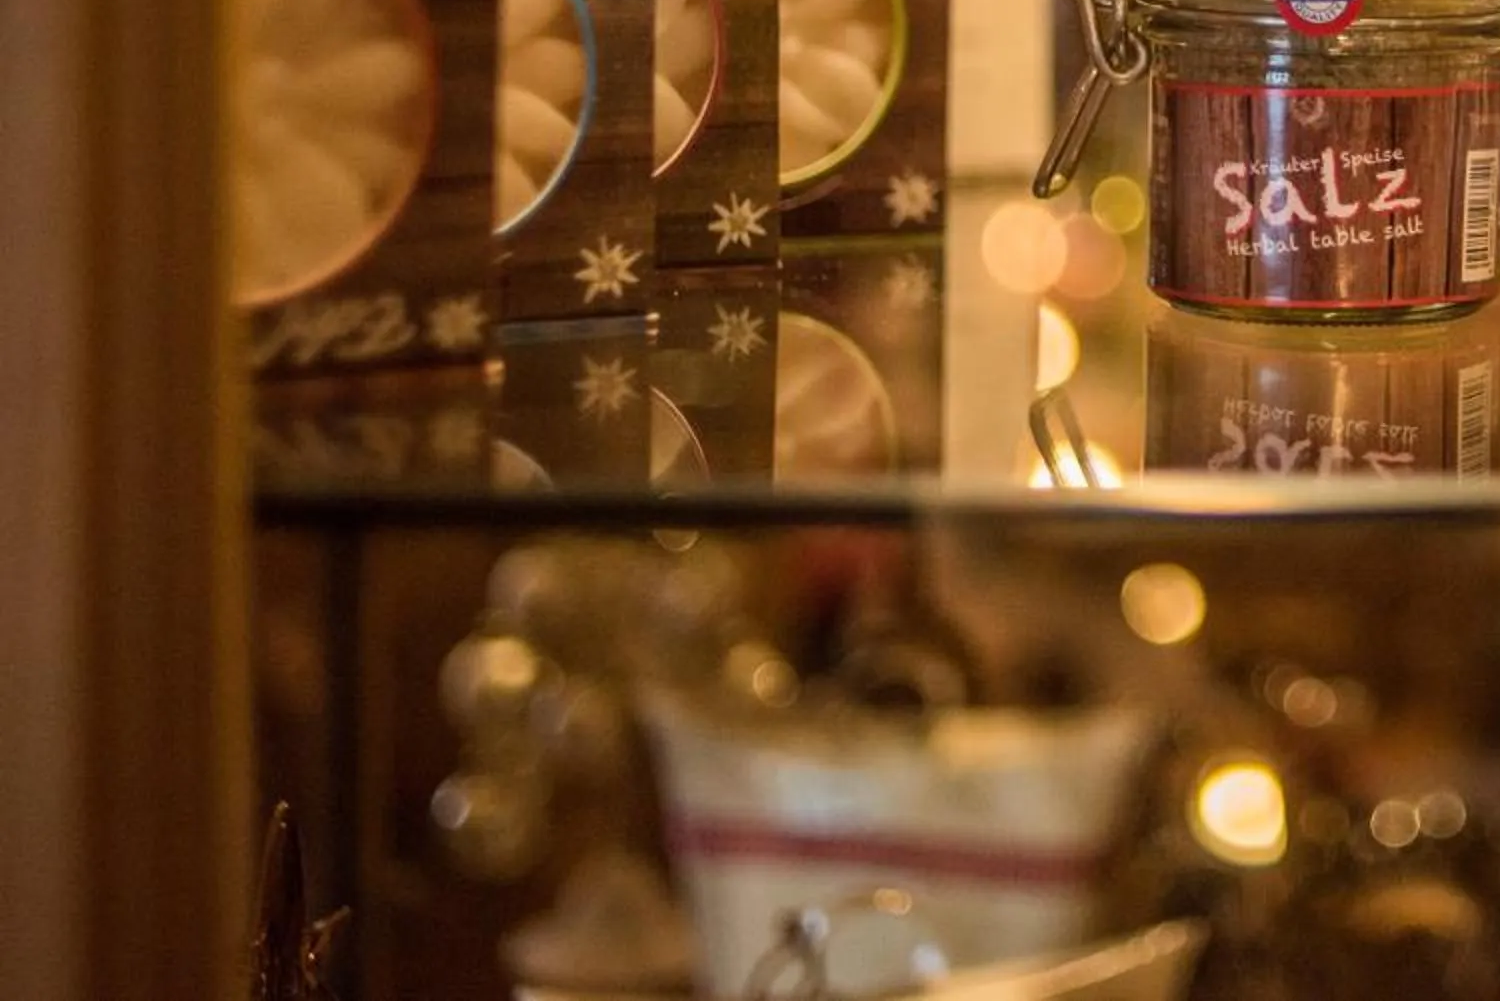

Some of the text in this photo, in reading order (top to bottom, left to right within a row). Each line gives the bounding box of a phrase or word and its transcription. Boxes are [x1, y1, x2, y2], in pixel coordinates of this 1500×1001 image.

[1340, 148, 1404, 177] Speise
[1227, 214, 1425, 256] Herbal table salt
